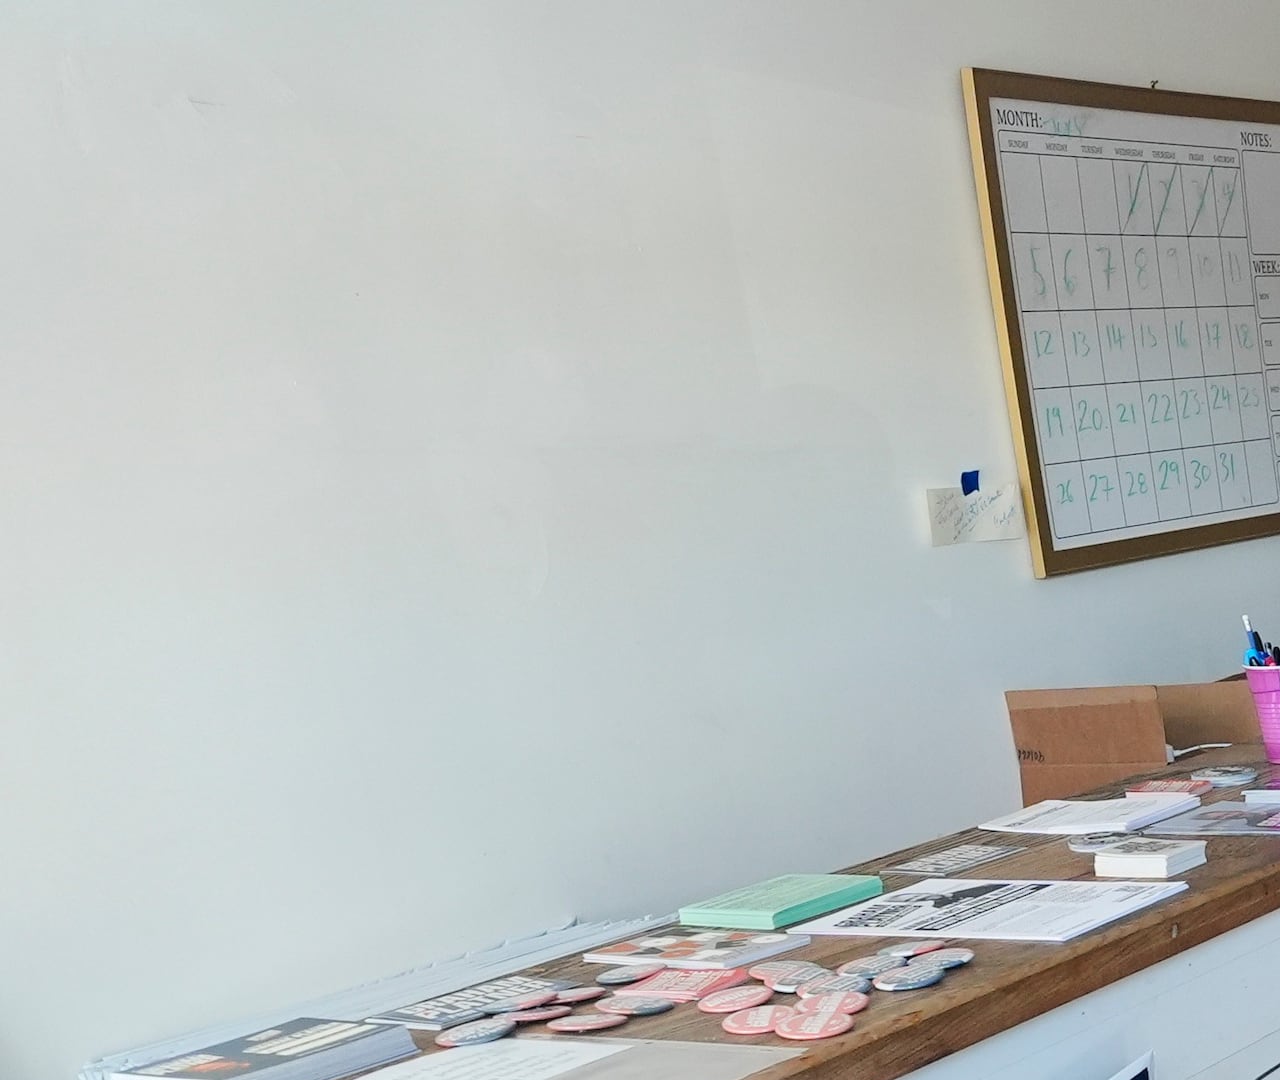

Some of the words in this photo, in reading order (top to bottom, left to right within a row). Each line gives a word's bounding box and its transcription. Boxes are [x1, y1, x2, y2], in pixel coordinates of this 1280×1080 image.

[996, 109, 1043, 129] MONTH:
[1240, 131, 1272, 148] NOTES:
[1030, 247, 1047, 297] 5
[1063, 249, 1076, 297] 6
[1096, 247, 1117, 292] 7
[1134, 247, 1149, 291] 8
[1252, 261, 1280, 274] WEEK:
[1033, 329, 1054, 358] 12
[1072, 330, 1090, 358] 13
[1105, 323, 1125, 350] 14
[1174, 320, 1188, 347] 16
[1205, 322, 1221, 349] 17
[1235, 323, 1254, 350] 18
[1046, 406, 1064, 438] 19
[1116, 403, 1136, 424] 21
[1148, 393, 1174, 424] 22
[1180, 388, 1201, 419] 23
[1211, 384, 1231, 411] 24
[1056, 480, 1074, 504] 26
[1089, 474, 1115, 501] 27
[1126, 471, 1148, 496] 28
[1159, 460, 1181, 490] 29
[1190, 460, 1212, 489] 30
[1219, 452, 1236, 482] 31
[396, 976, 533, 1014] GRAHAM
[415, 980, 555, 1019] PLATNER
